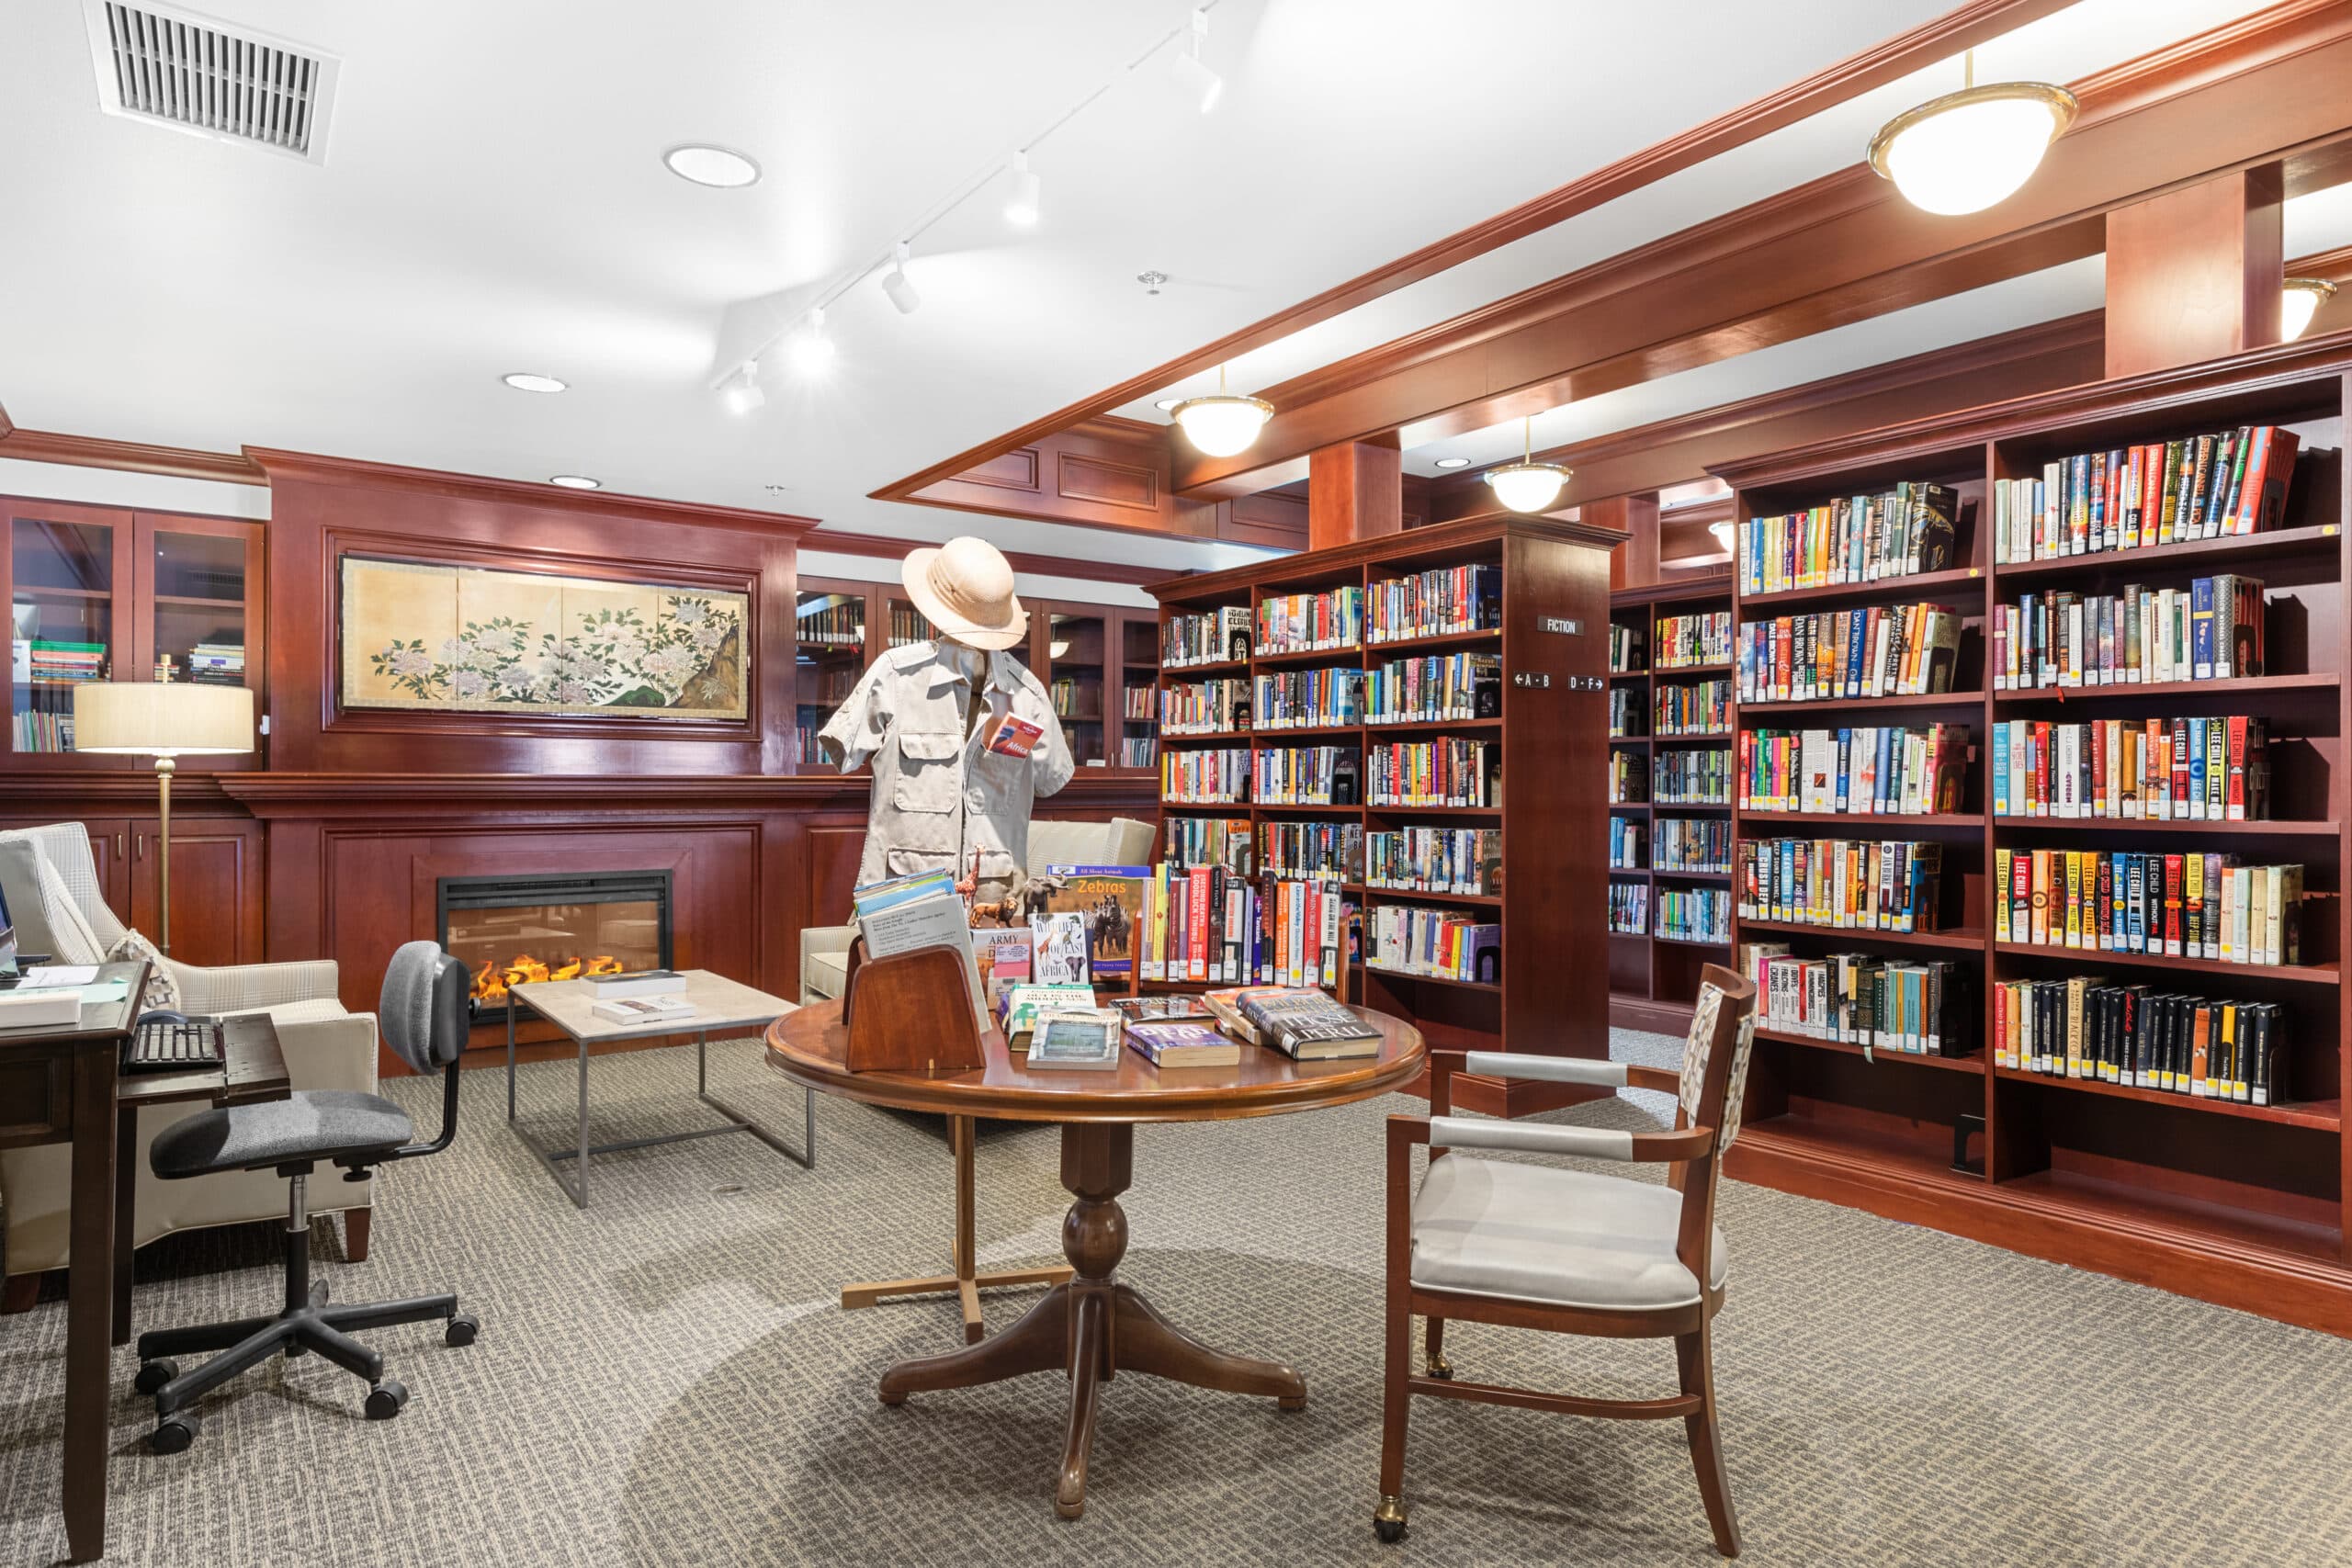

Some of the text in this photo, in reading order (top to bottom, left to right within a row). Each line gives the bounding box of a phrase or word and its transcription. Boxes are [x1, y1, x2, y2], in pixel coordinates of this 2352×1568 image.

[2196, 468, 2207, 496] CANNELL
[2128, 513, 2137, 530] COLD
[1547, 619, 1576, 633] FICTION
[1794, 618, 1804, 664] DAN BROWN
[1851, 633, 1860, 661] BROWN
[1525, 674, 1531, 686] A
[1544, 677, 1549, 687] B
[1571, 678, 1577, 688] D
[1588, 678, 1593, 690] F
[2175, 730, 2186, 760] LEE CHILD
[2211, 732, 2222, 745] LEE
[1007, 742, 1028, 754] Africa
[2211, 745, 2222, 764] CHILD
[2233, 744, 2242, 763] CHILD
[2211, 777, 2220, 795] MAKE
[1795, 845, 1804, 865] TIDAL
[1795, 868, 1804, 882] RIP
[1882, 856, 1892, 885] JAN BURKE
[2069, 864, 2077, 874] LEE
[2131, 868, 2140, 878] LEE
[2150, 860, 2159, 872] LEE
[1078, 880, 1125, 893] Zebras
[1758, 857, 1769, 903] CRUSH DEP
[2016, 862, 2027, 896] LEE CHILD
[2069, 876, 2077, 895] CHILD
[2085, 867, 2093, 897] LEE CHILD
[2131, 879, 2140, 897] CHILD
[2150, 874, 2158, 893] CHILD
[2168, 869, 2177, 897] LEE CHILD
[2189, 858, 2199, 929] LINCOLN CHILD DEEP
[2132, 922, 2140, 935] HOU
[989, 935, 1018, 944] ARMY
[1041, 965, 1069, 976] AFRICA
[1284, 1013, 1357, 1027] THOSE
[2070, 1016, 2079, 1039] BLACK
[1301, 1026, 1372, 1039] PERIL
